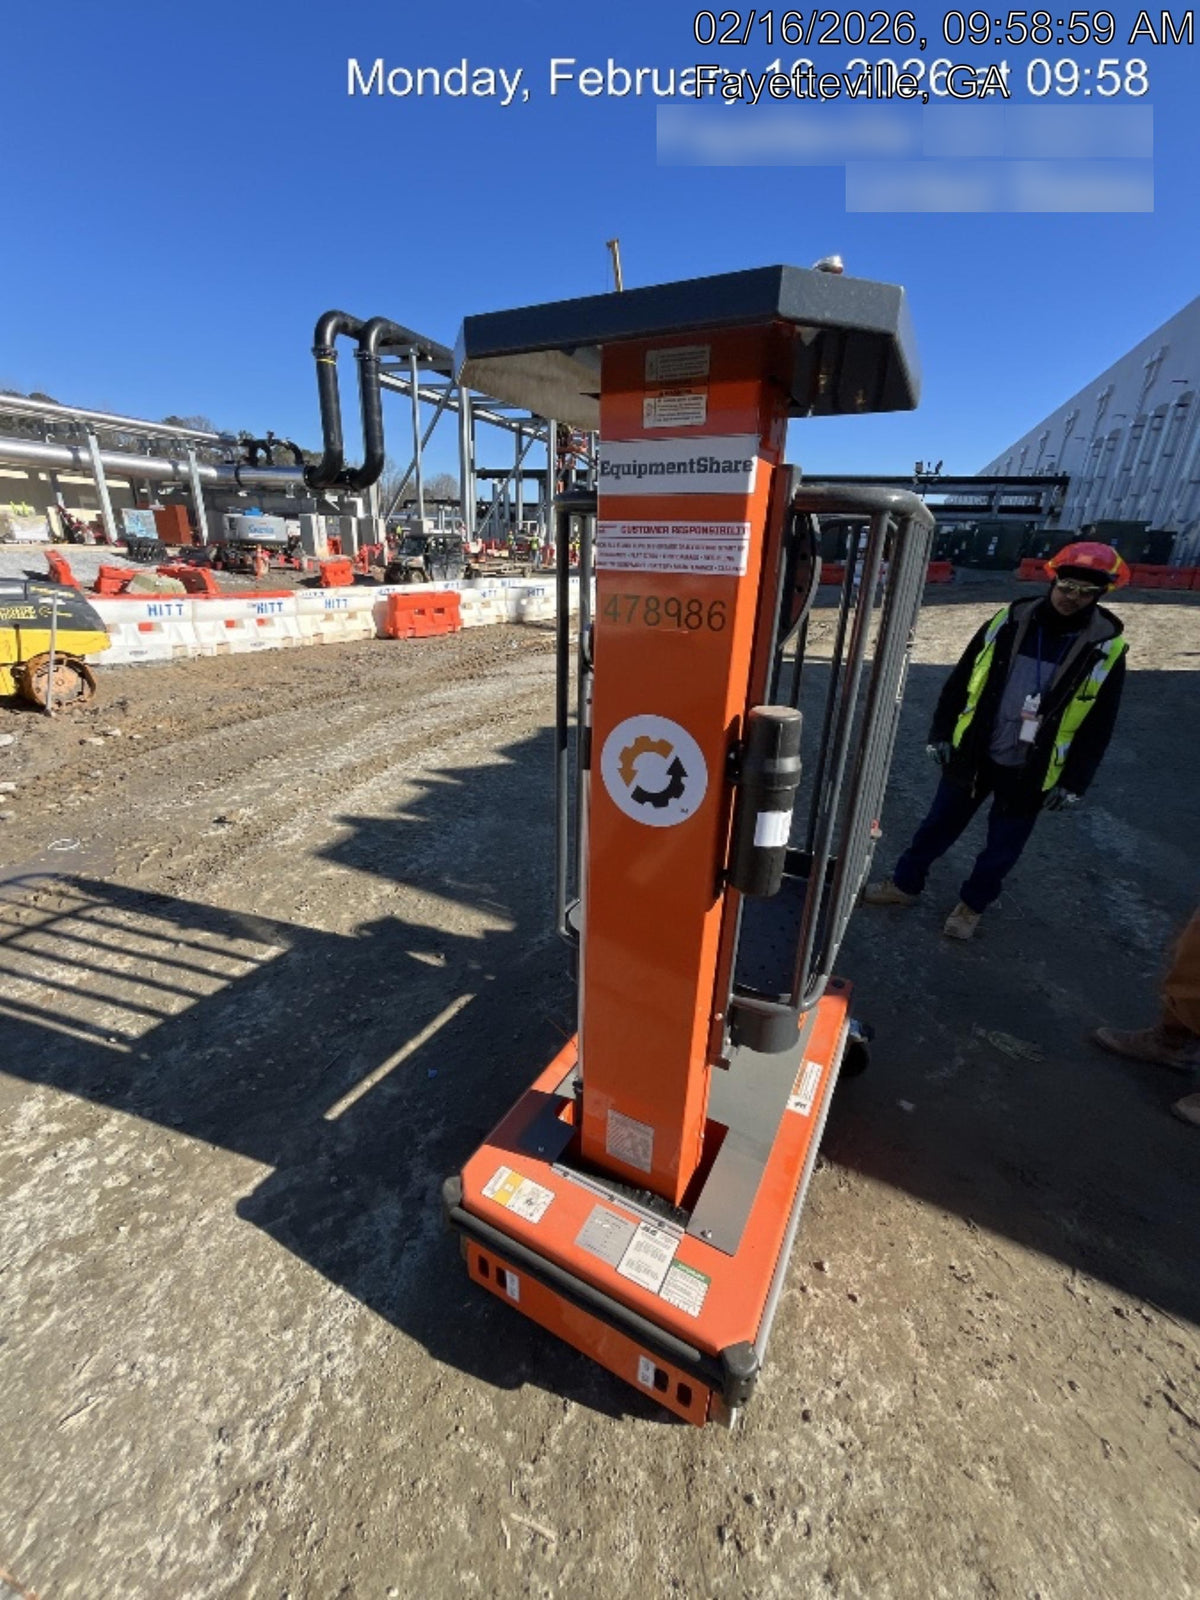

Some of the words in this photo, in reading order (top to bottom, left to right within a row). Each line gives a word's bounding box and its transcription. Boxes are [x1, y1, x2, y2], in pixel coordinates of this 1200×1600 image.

[600, 456, 753, 479] EquipmentShare
[256, 601, 284, 614] HITT
[324, 598, 347, 609] HITT
[147, 604, 184, 617] HITT
[603, 593, 727, 632] 478986
